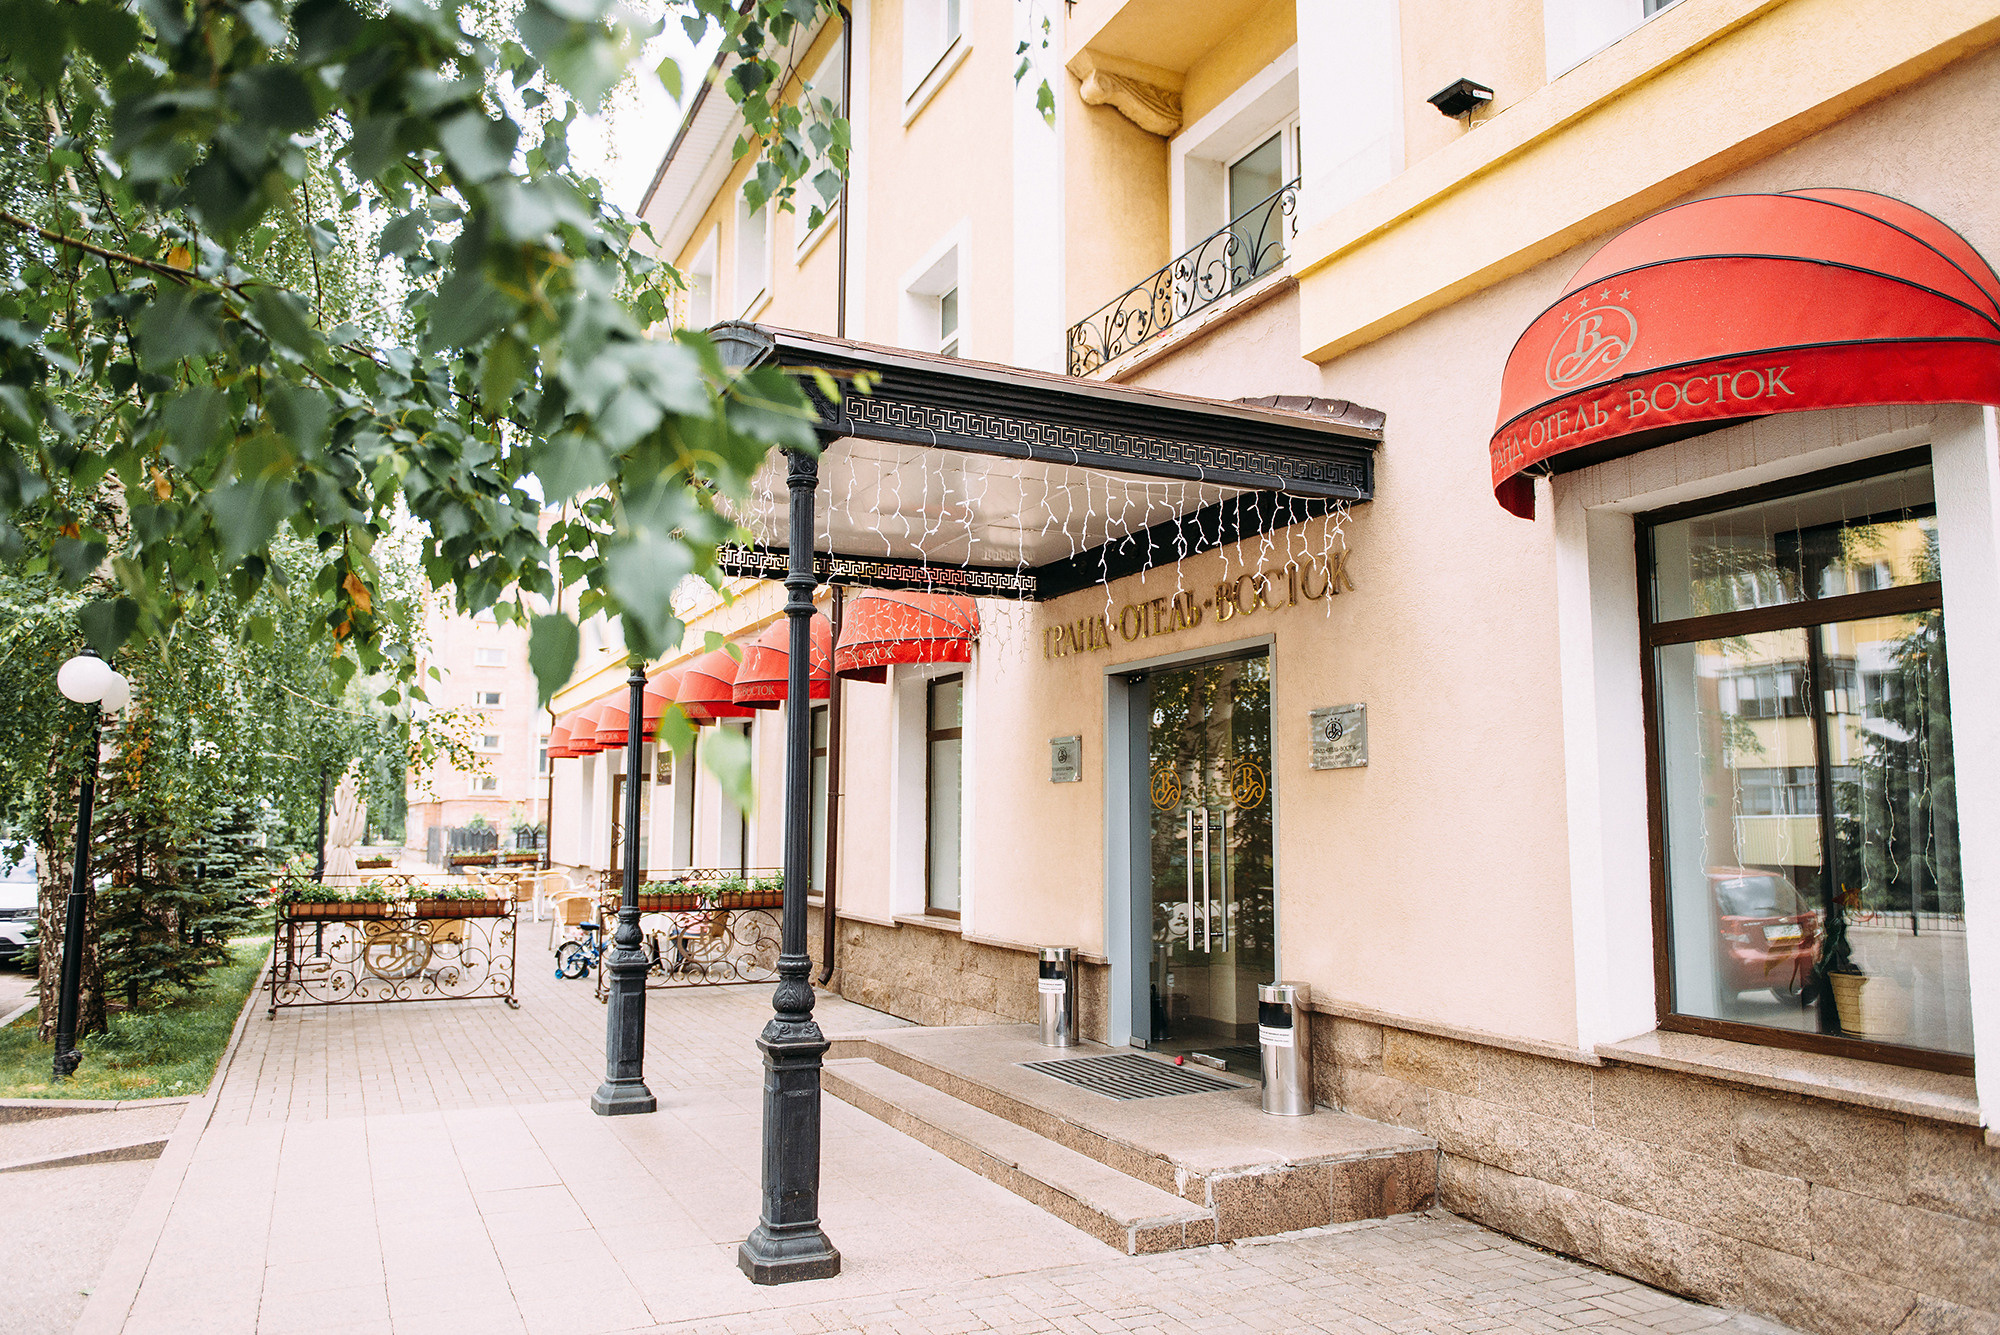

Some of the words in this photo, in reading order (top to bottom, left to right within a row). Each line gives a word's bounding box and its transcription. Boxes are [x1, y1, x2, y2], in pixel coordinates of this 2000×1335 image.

[1529, 400, 1609, 449] ОТЕЛЬ
[1626, 366, 1795, 419] ВОСТОК
[1042, 613, 1112, 660] ГРАНД
[1119, 590, 1202, 642] ОТЕЛЬ
[1214, 549, 1354, 622] ВОСТОК
